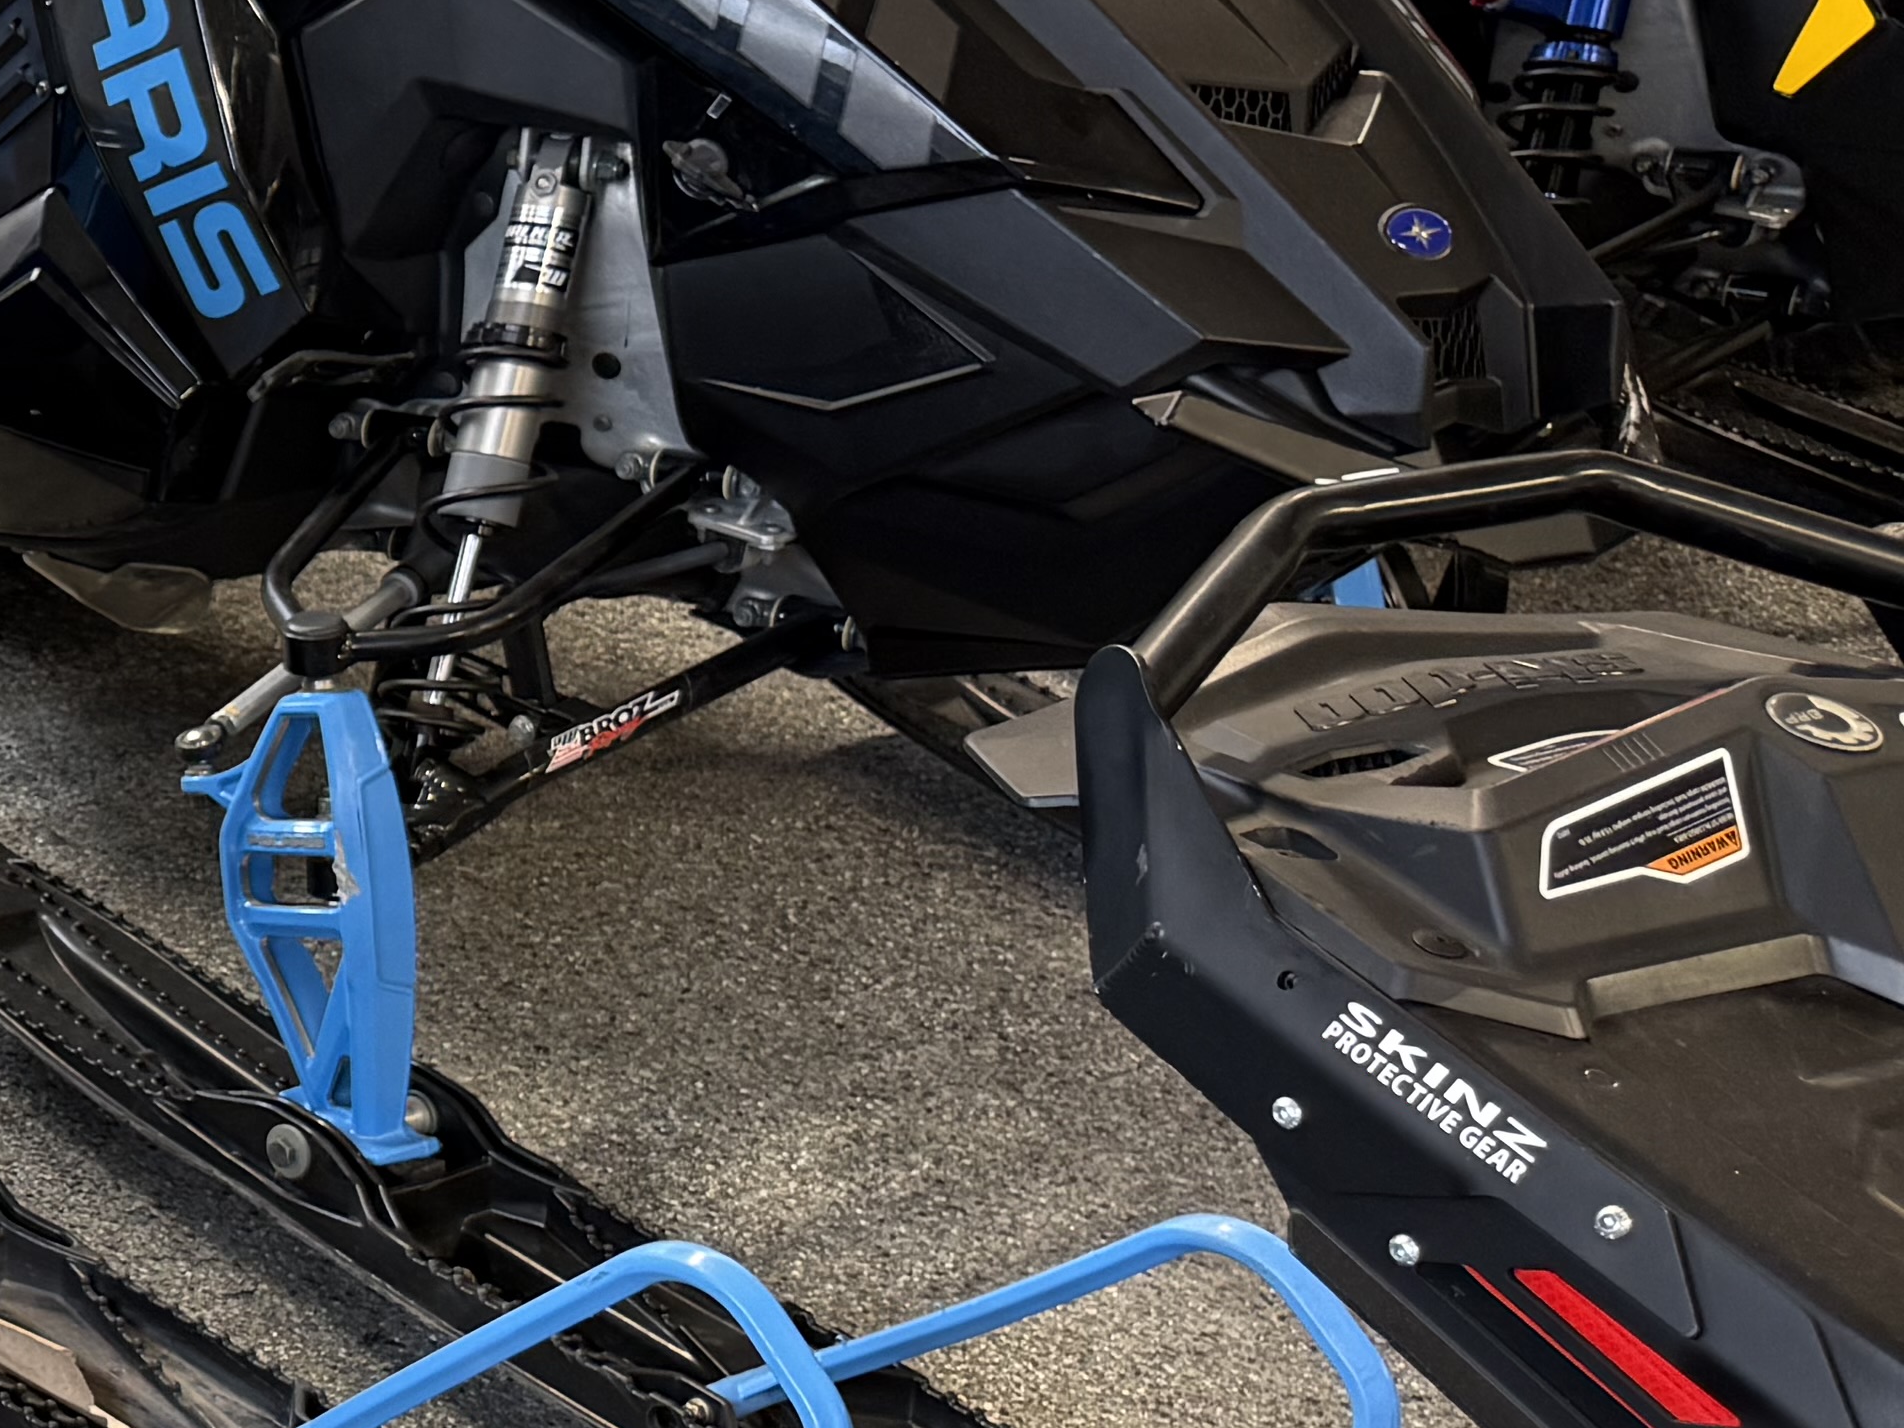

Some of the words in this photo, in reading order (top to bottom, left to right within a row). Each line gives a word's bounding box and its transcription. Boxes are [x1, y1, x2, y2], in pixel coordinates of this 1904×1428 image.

[1667, 837, 1729, 870] WARNING
[1321, 1020, 1463, 1135] PROTECTIVE
[1458, 1125, 1529, 1185] GEAR
[1339, 1001, 1548, 1164] SKINZ
